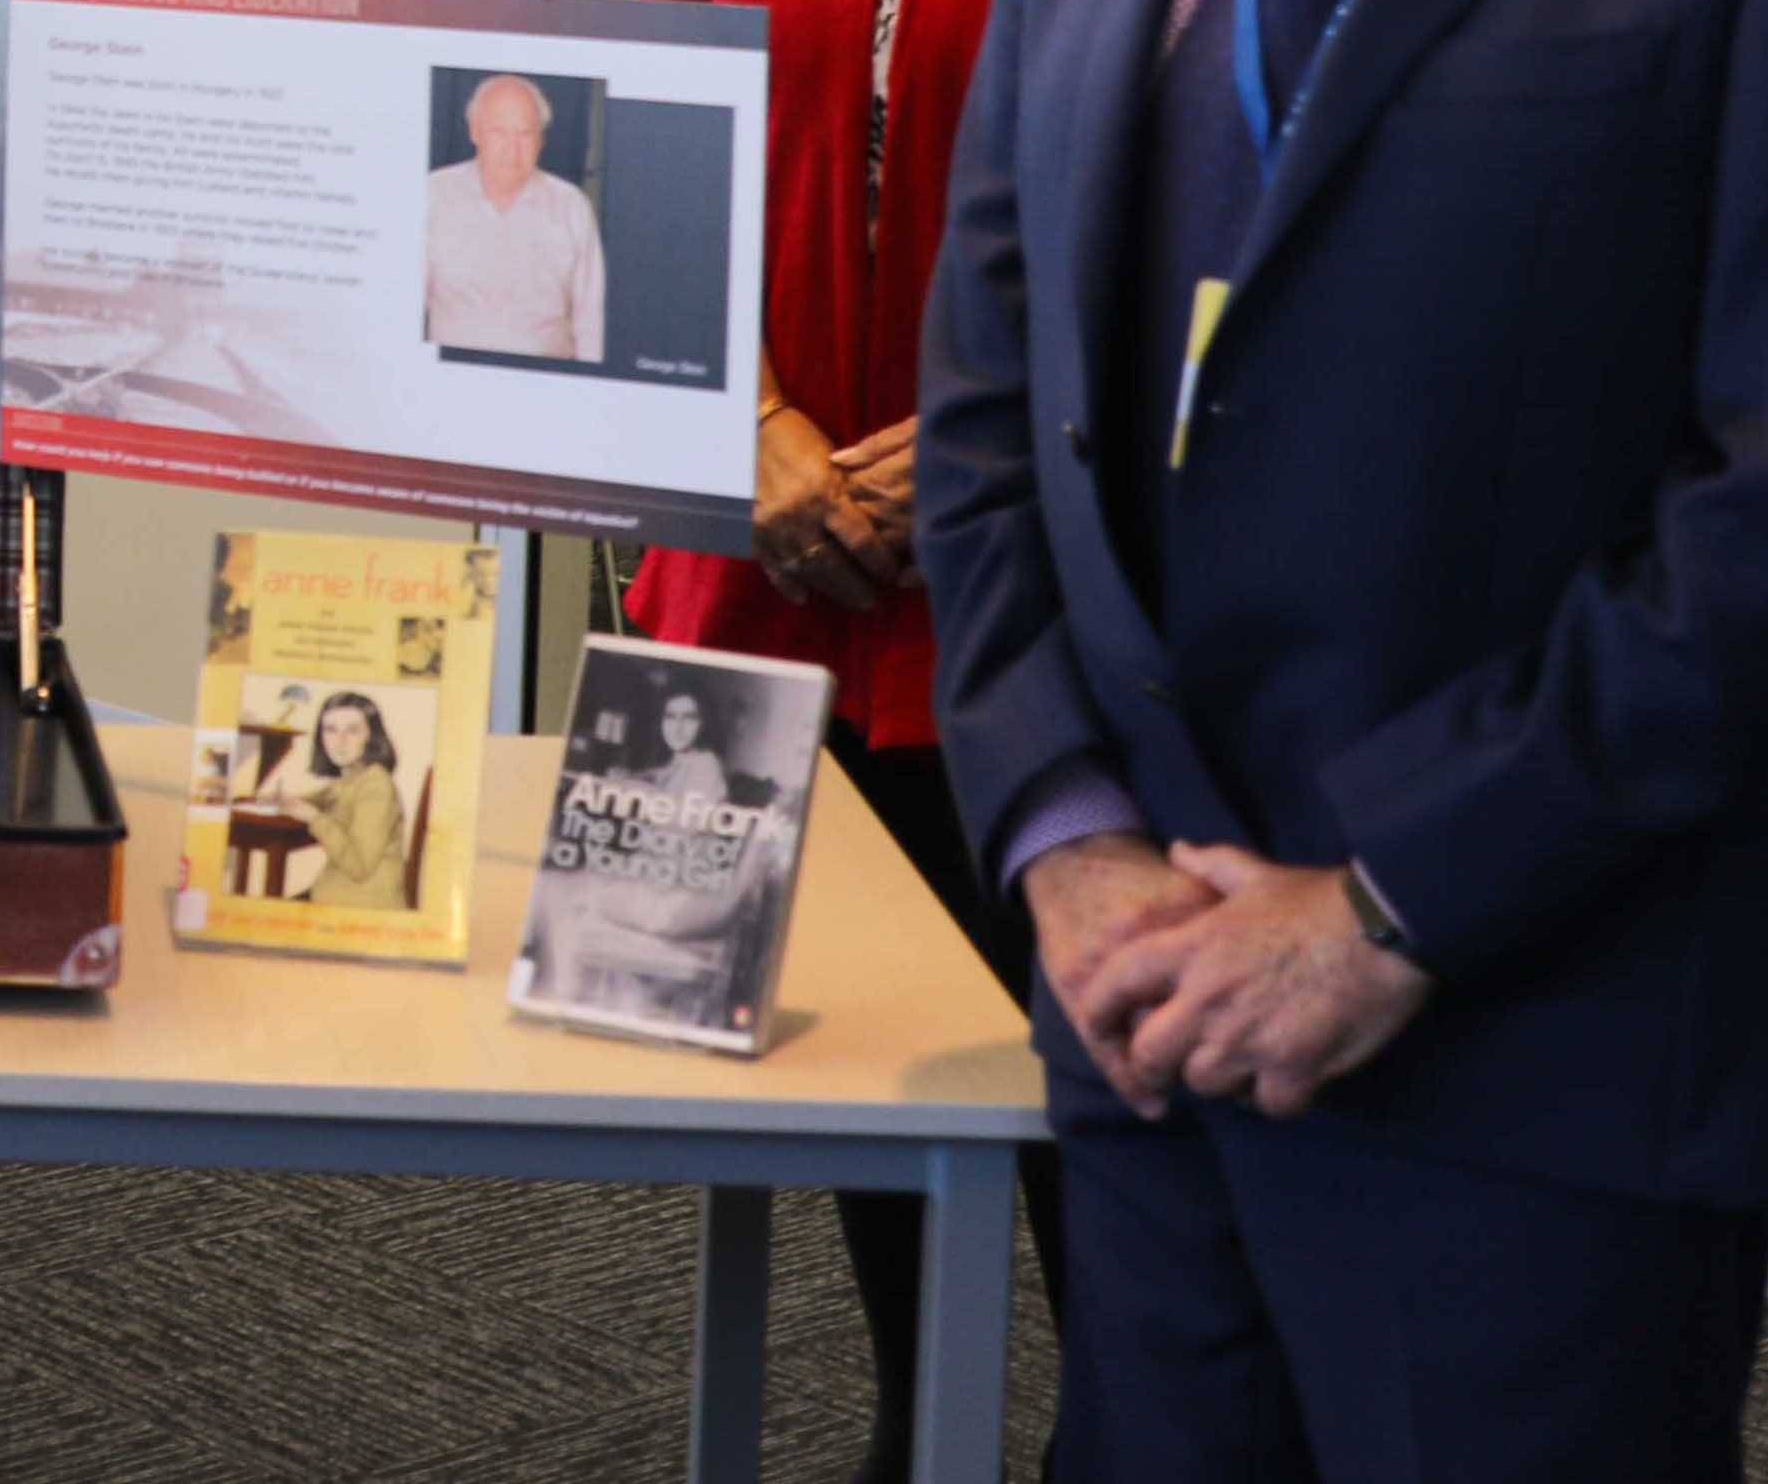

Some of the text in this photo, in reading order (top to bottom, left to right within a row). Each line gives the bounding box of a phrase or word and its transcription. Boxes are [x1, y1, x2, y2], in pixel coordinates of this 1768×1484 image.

[262, 553, 451, 606] anne frank
[566, 774, 788, 841] Anne Frank
[559, 810, 744, 862] The Diary of
[550, 841, 737, 893] a Young Girl
